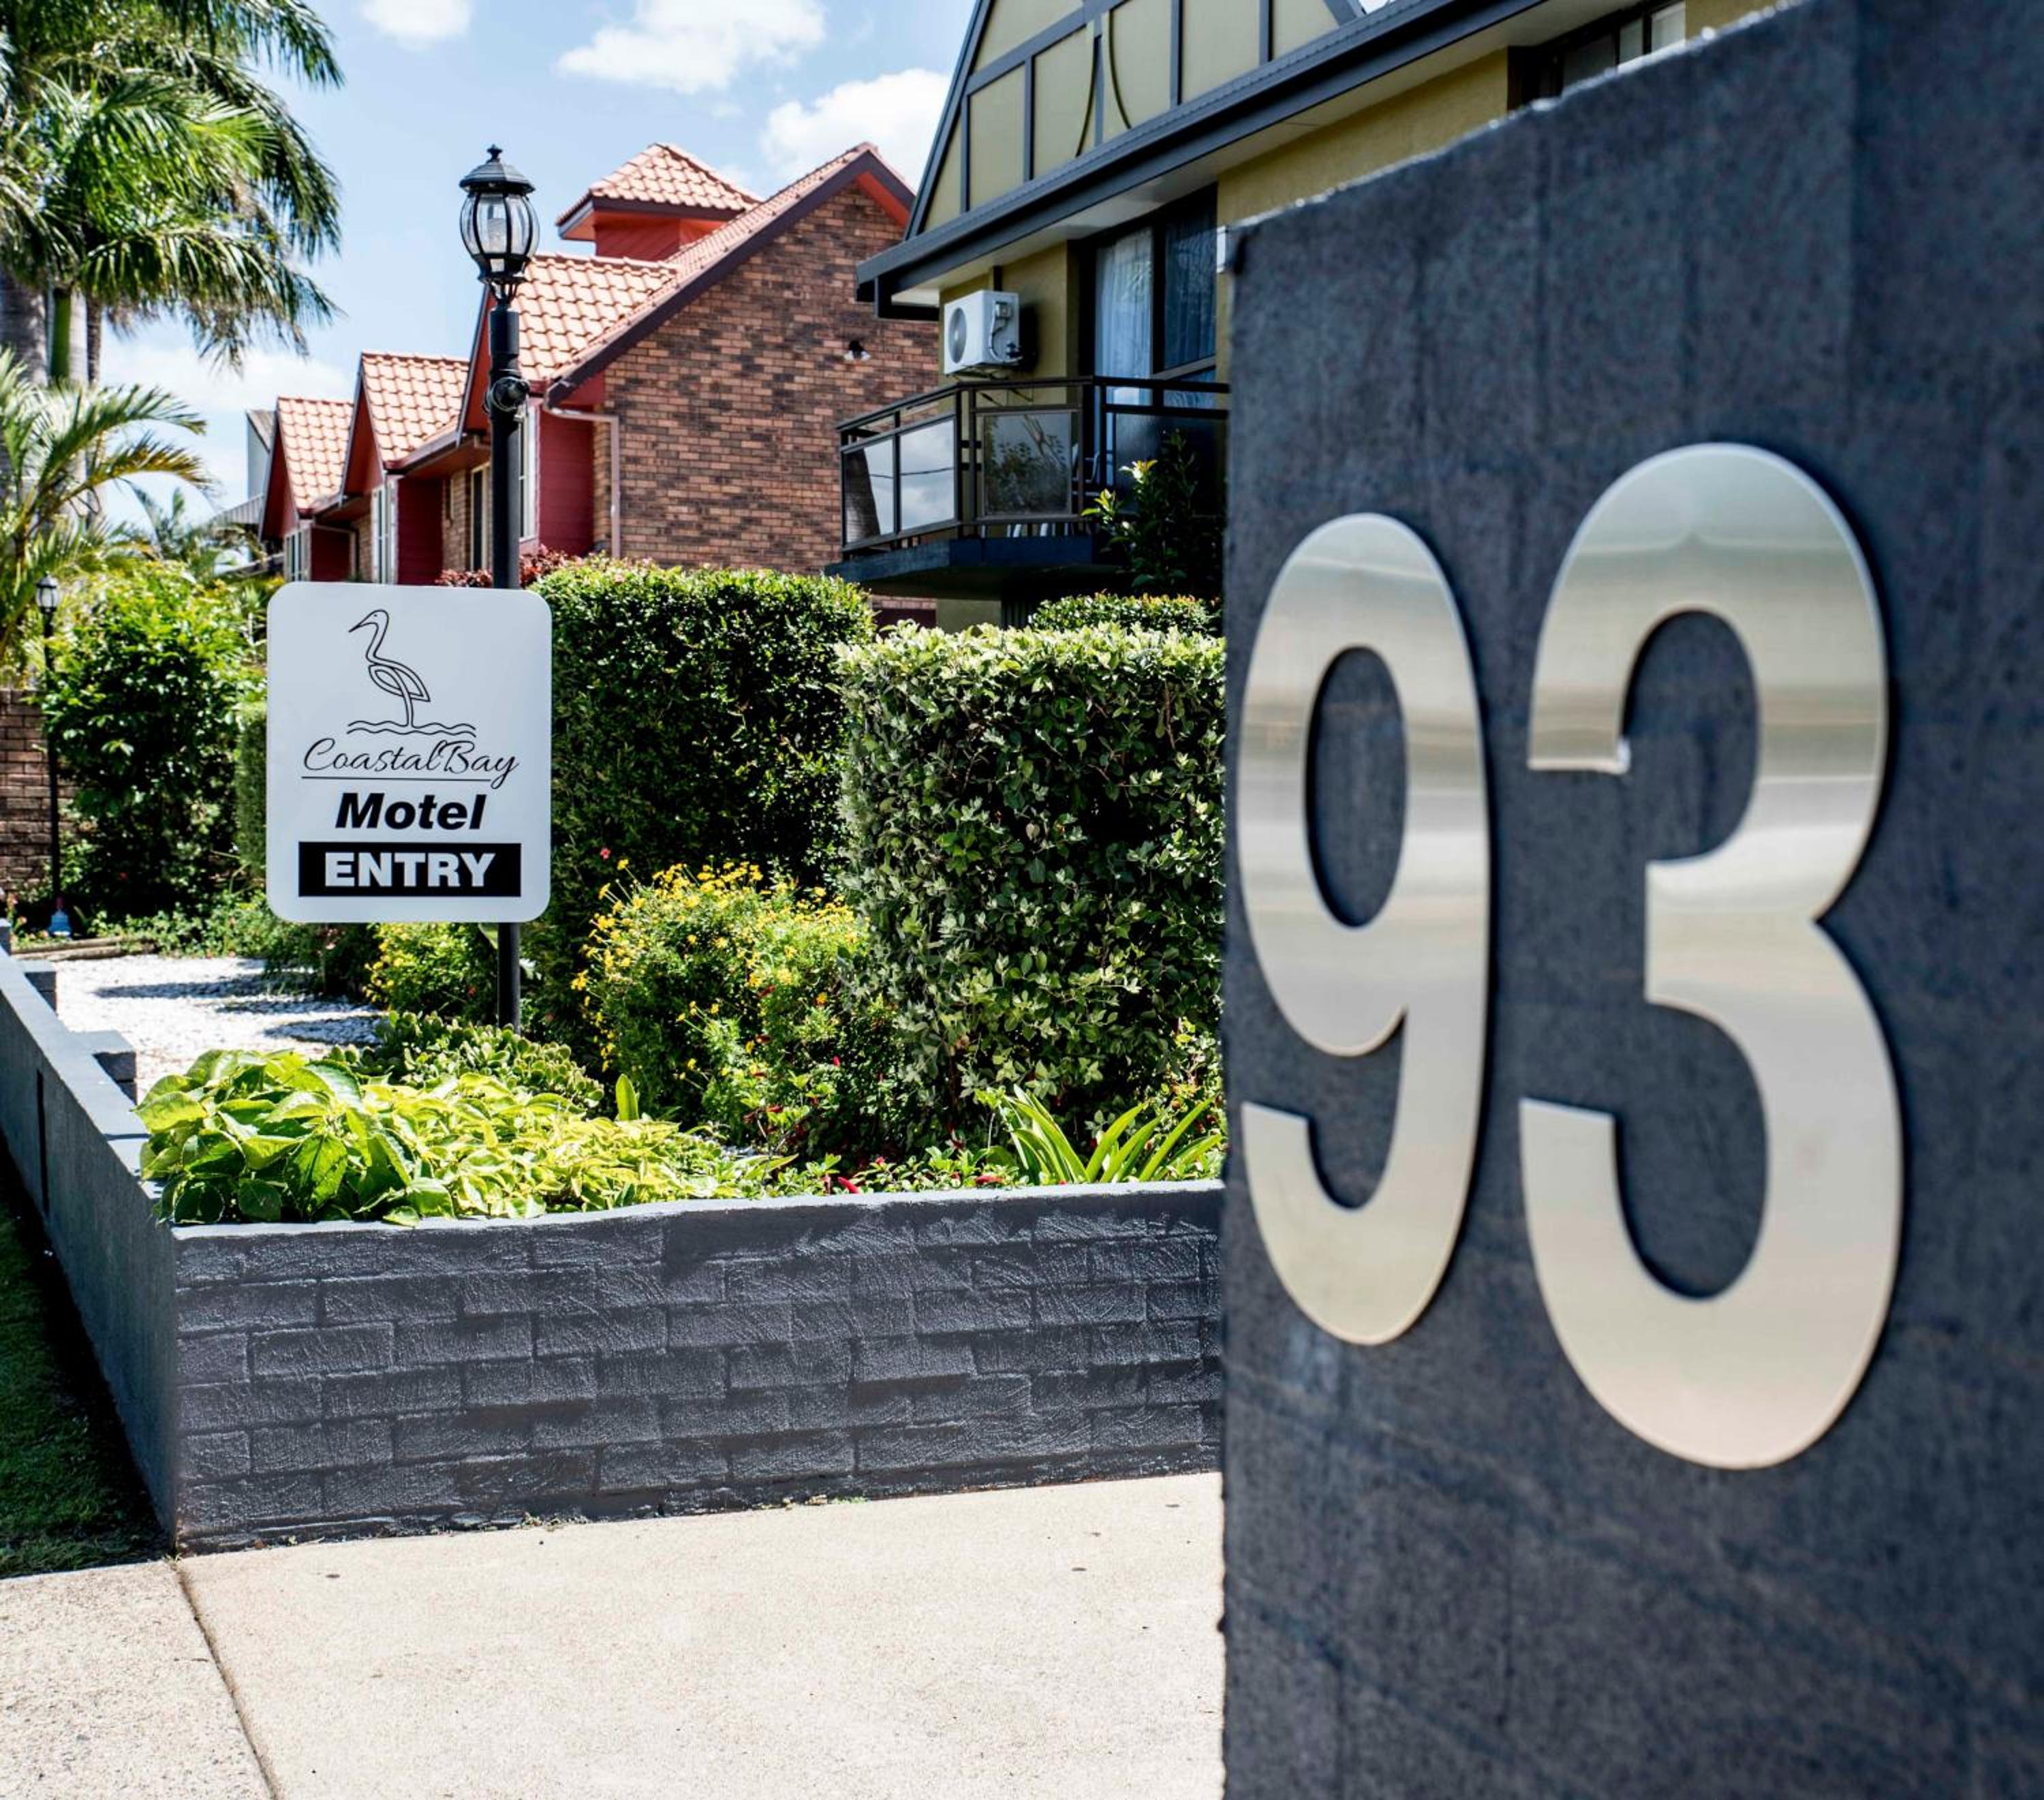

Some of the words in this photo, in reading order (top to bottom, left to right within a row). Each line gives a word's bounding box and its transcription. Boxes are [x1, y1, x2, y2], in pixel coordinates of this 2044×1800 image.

[335, 792, 487, 830] Motel
[325, 852, 495, 887] ENTRY
[1239, 443, 1902, 1469] 93
